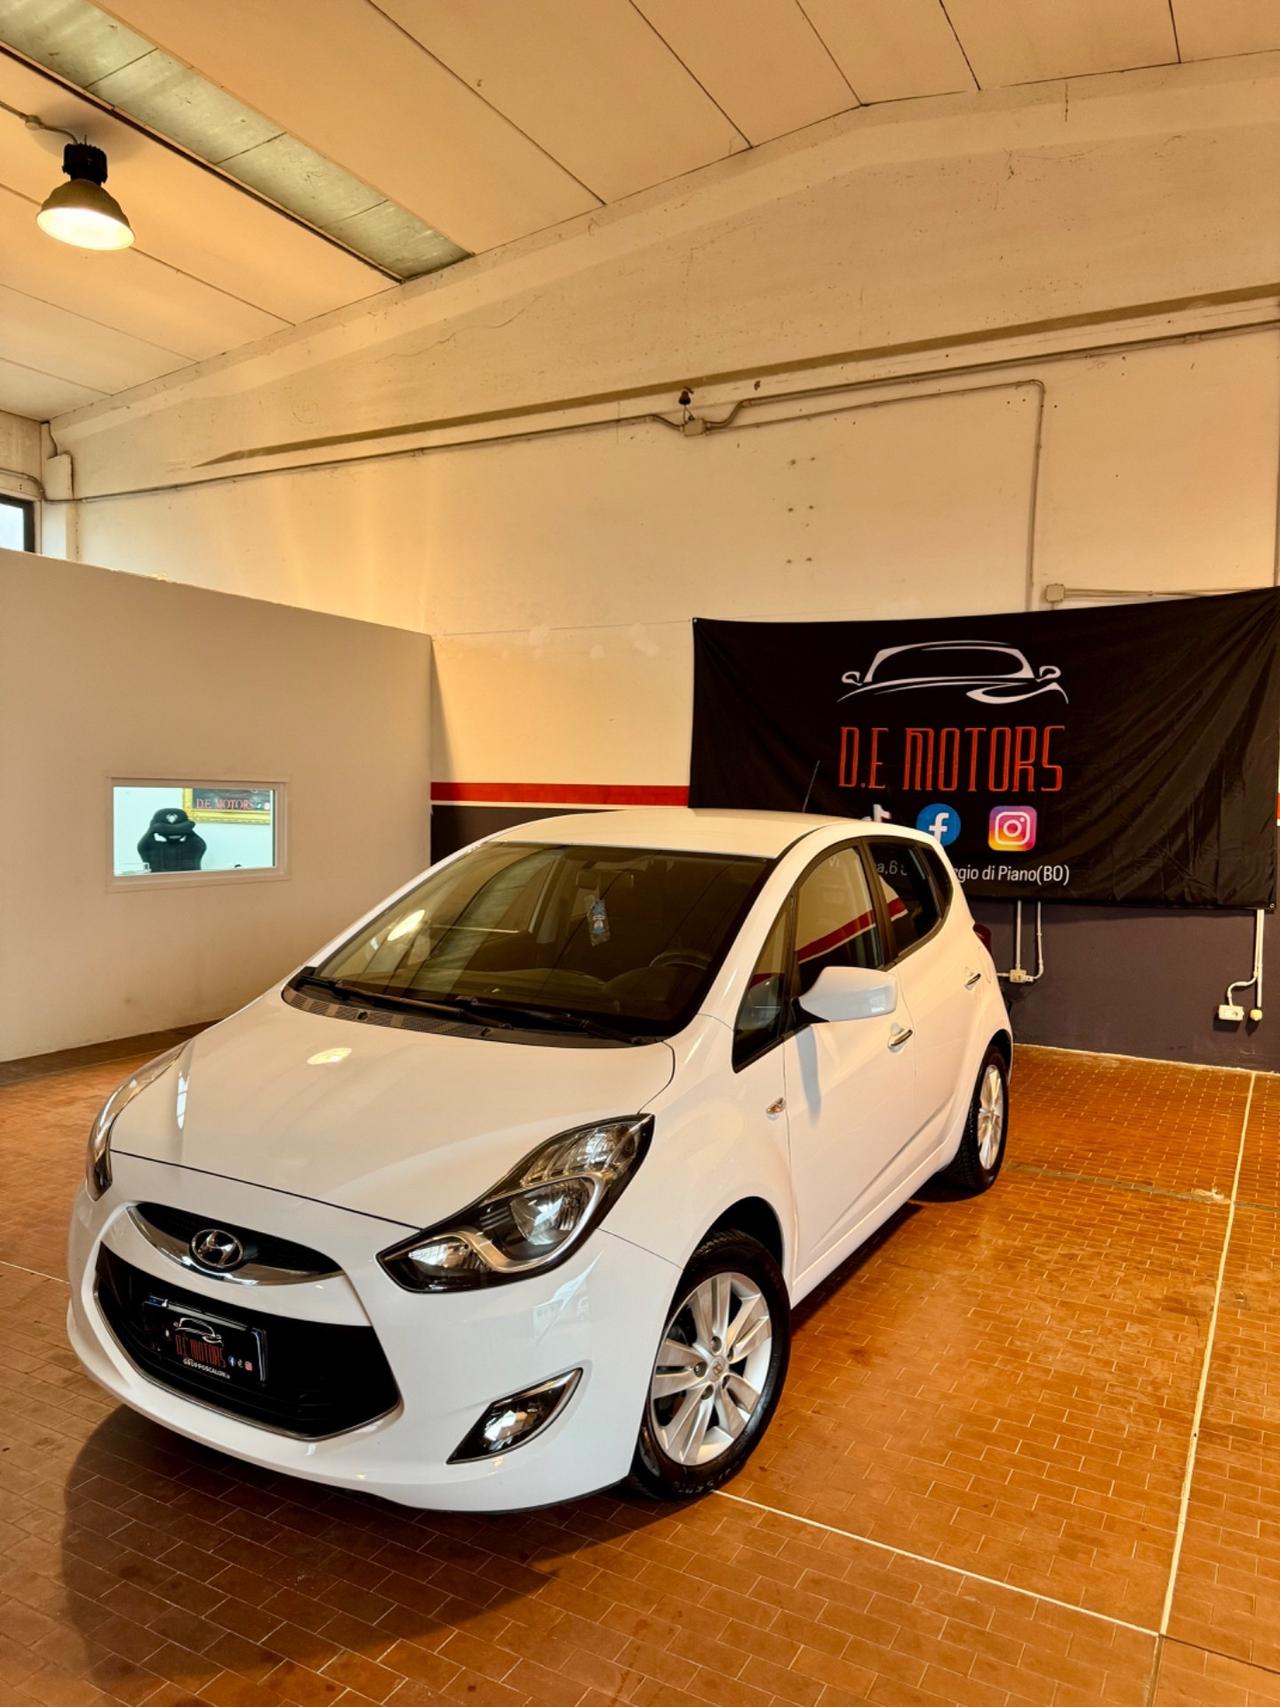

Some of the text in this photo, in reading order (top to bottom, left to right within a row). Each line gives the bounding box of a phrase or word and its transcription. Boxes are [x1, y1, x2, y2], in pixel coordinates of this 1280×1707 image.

[838, 725, 1066, 792] D.E MOTORS
[216, 798, 254, 810] MOTORS
[981, 865, 995, 880] di
[997, 864, 1070, 886] Piano(BO)
